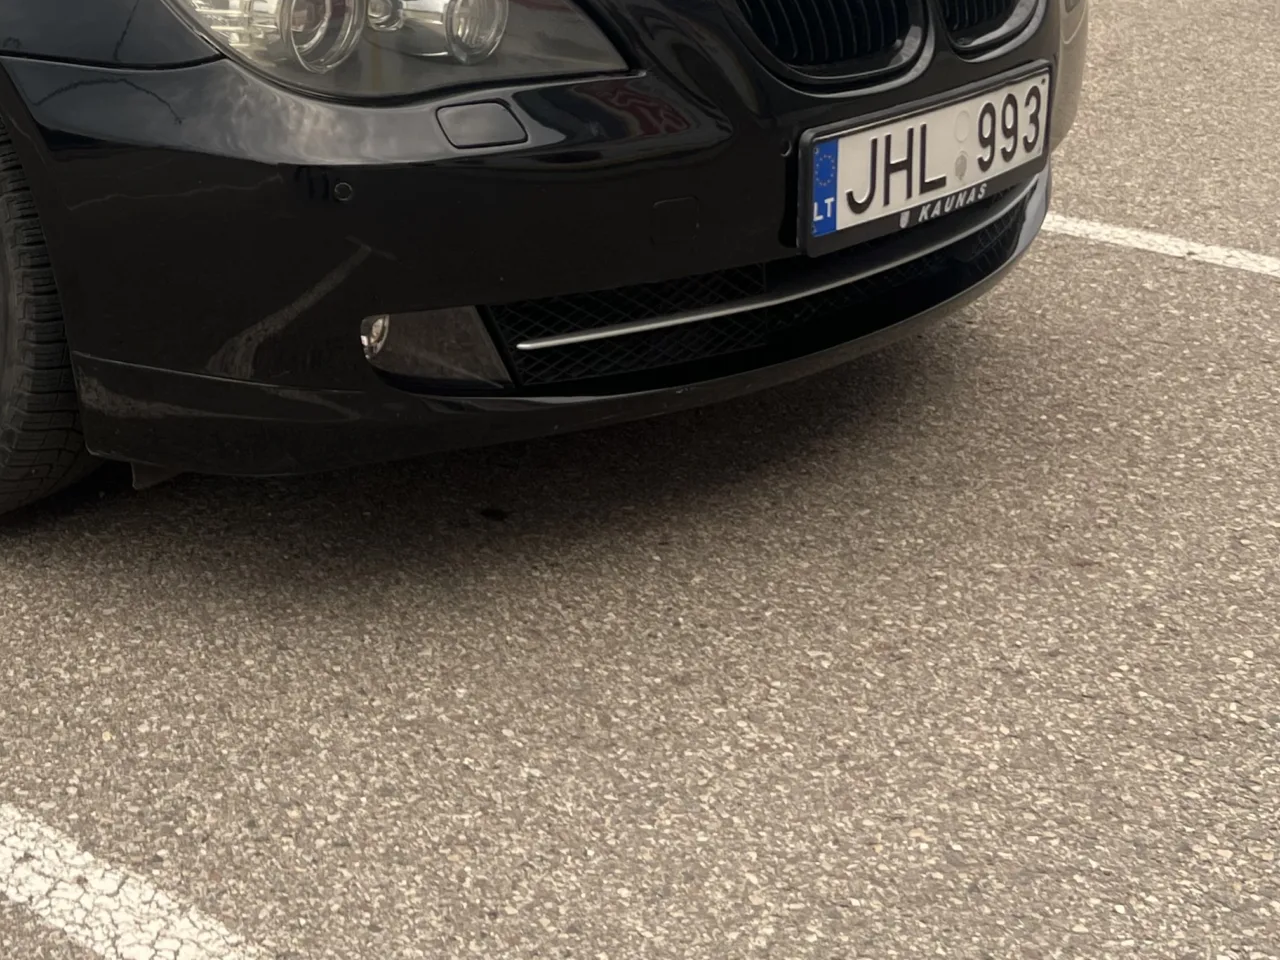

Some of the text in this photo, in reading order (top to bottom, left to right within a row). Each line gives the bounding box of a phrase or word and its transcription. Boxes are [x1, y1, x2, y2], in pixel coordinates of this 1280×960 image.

[845, 85, 1041, 215] JHL 993
[813, 197, 835, 221] LT
[918, 182, 987, 224] KAUNAS
